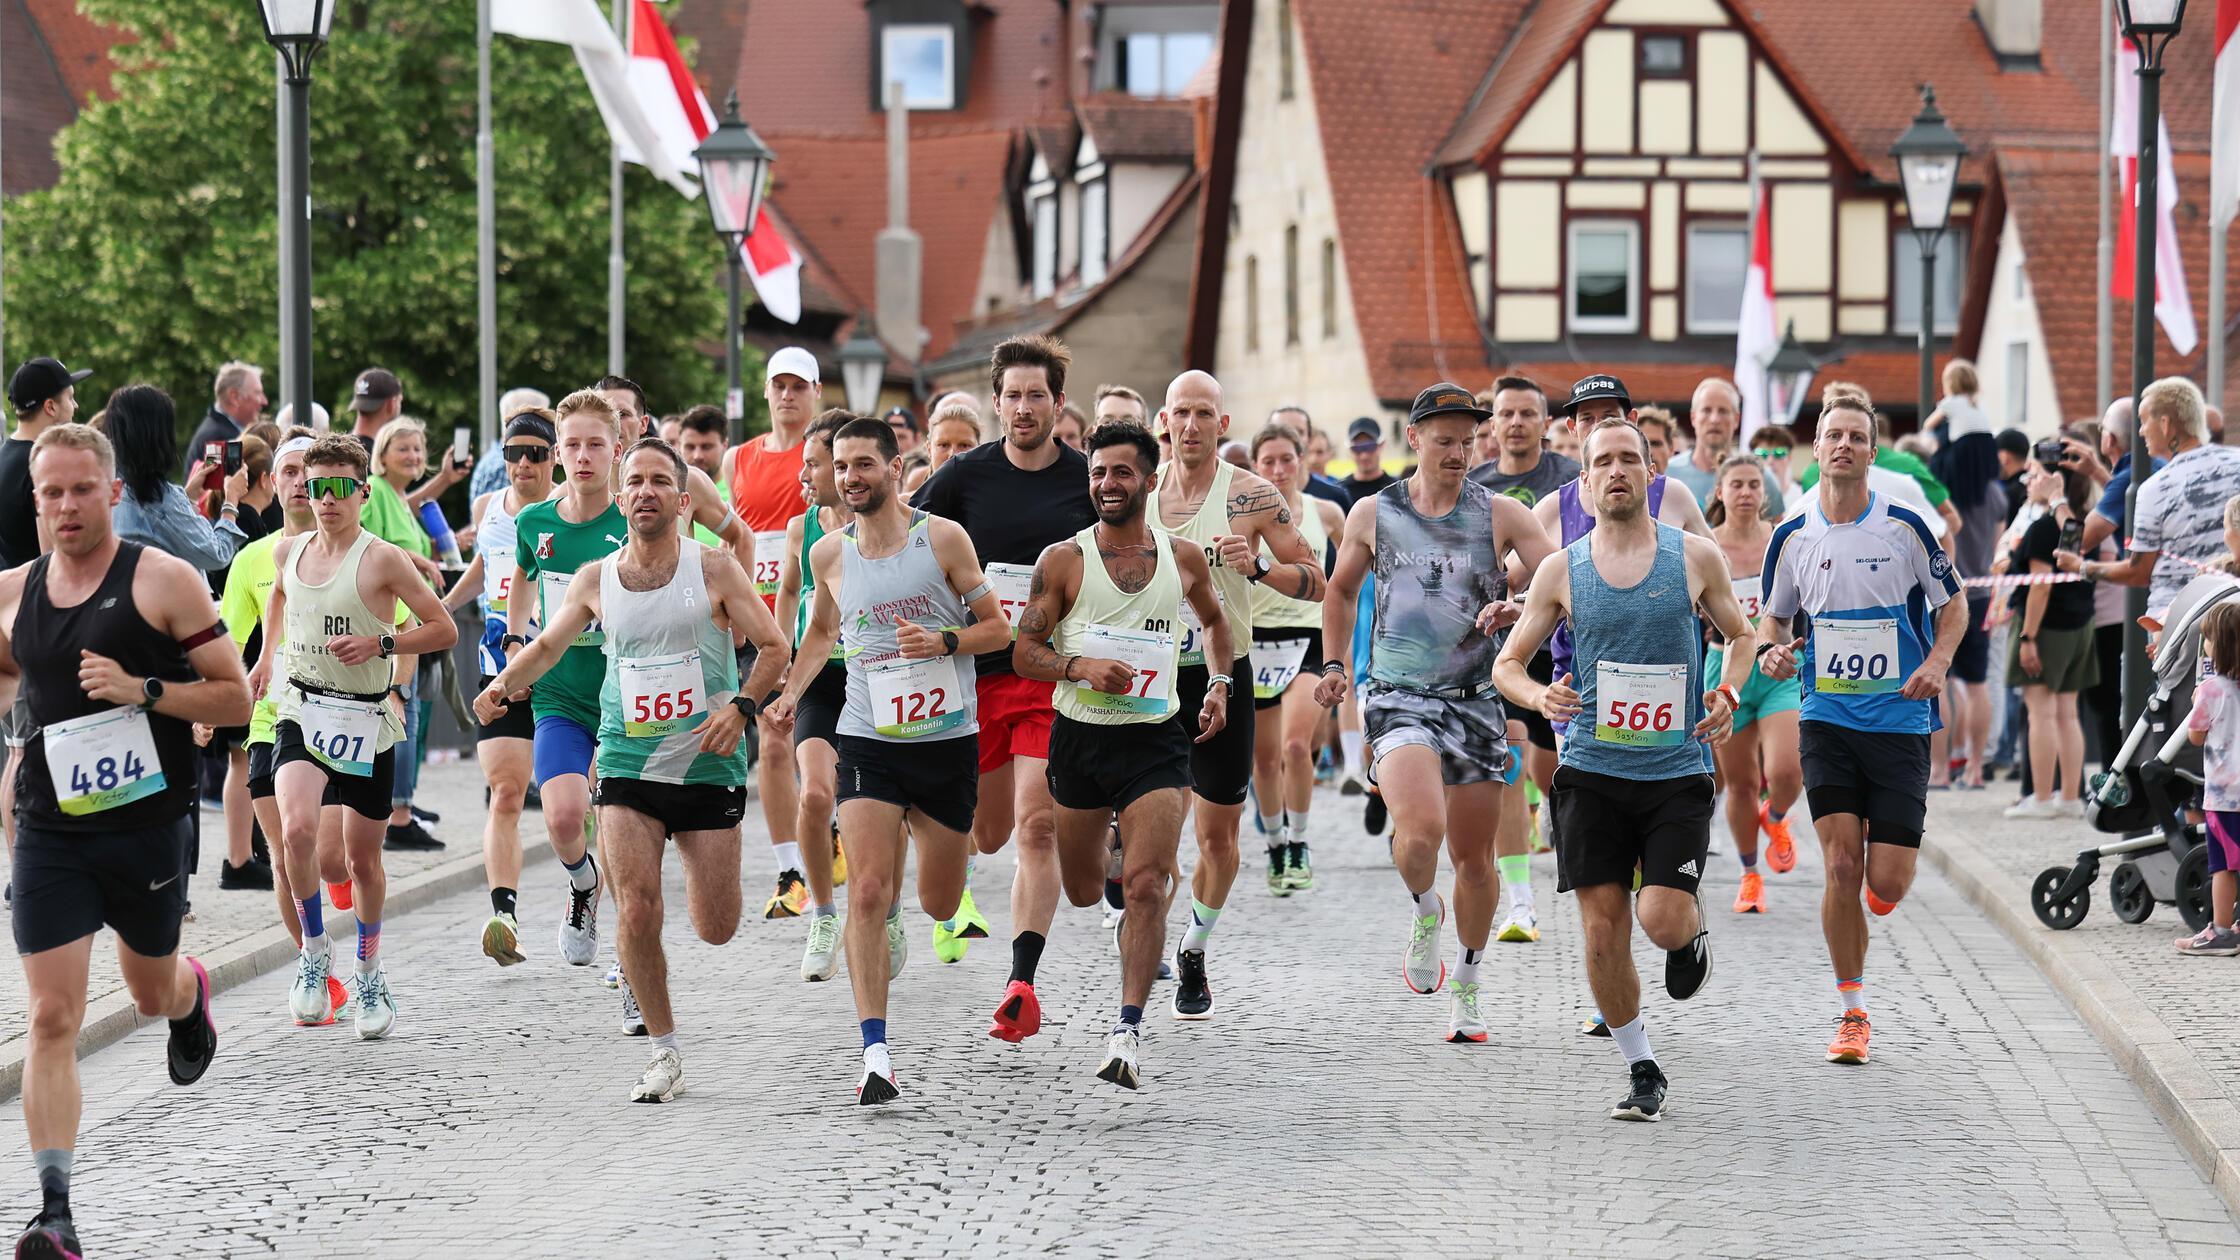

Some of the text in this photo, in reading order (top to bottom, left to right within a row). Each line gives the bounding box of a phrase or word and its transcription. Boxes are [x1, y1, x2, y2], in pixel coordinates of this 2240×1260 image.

[1575, 381, 1615, 396] surpas
[497, 578, 511, 600] 5
[324, 615, 353, 636] RCL
[311, 645, 337, 655] CRE
[860, 648, 901, 667] konstant
[1180, 655, 1200, 663] orian
[1827, 653, 1888, 681] 490
[635, 688, 694, 723] 565
[891, 688, 946, 725] 122
[901, 719, 944, 734] Konstantin
[1607, 701, 1673, 732] 566
[312, 730, 364, 762] 401
[1615, 730, 1649, 743] Bastian
[71, 750, 145, 795] 484
[89, 790, 131, 806] Victor
